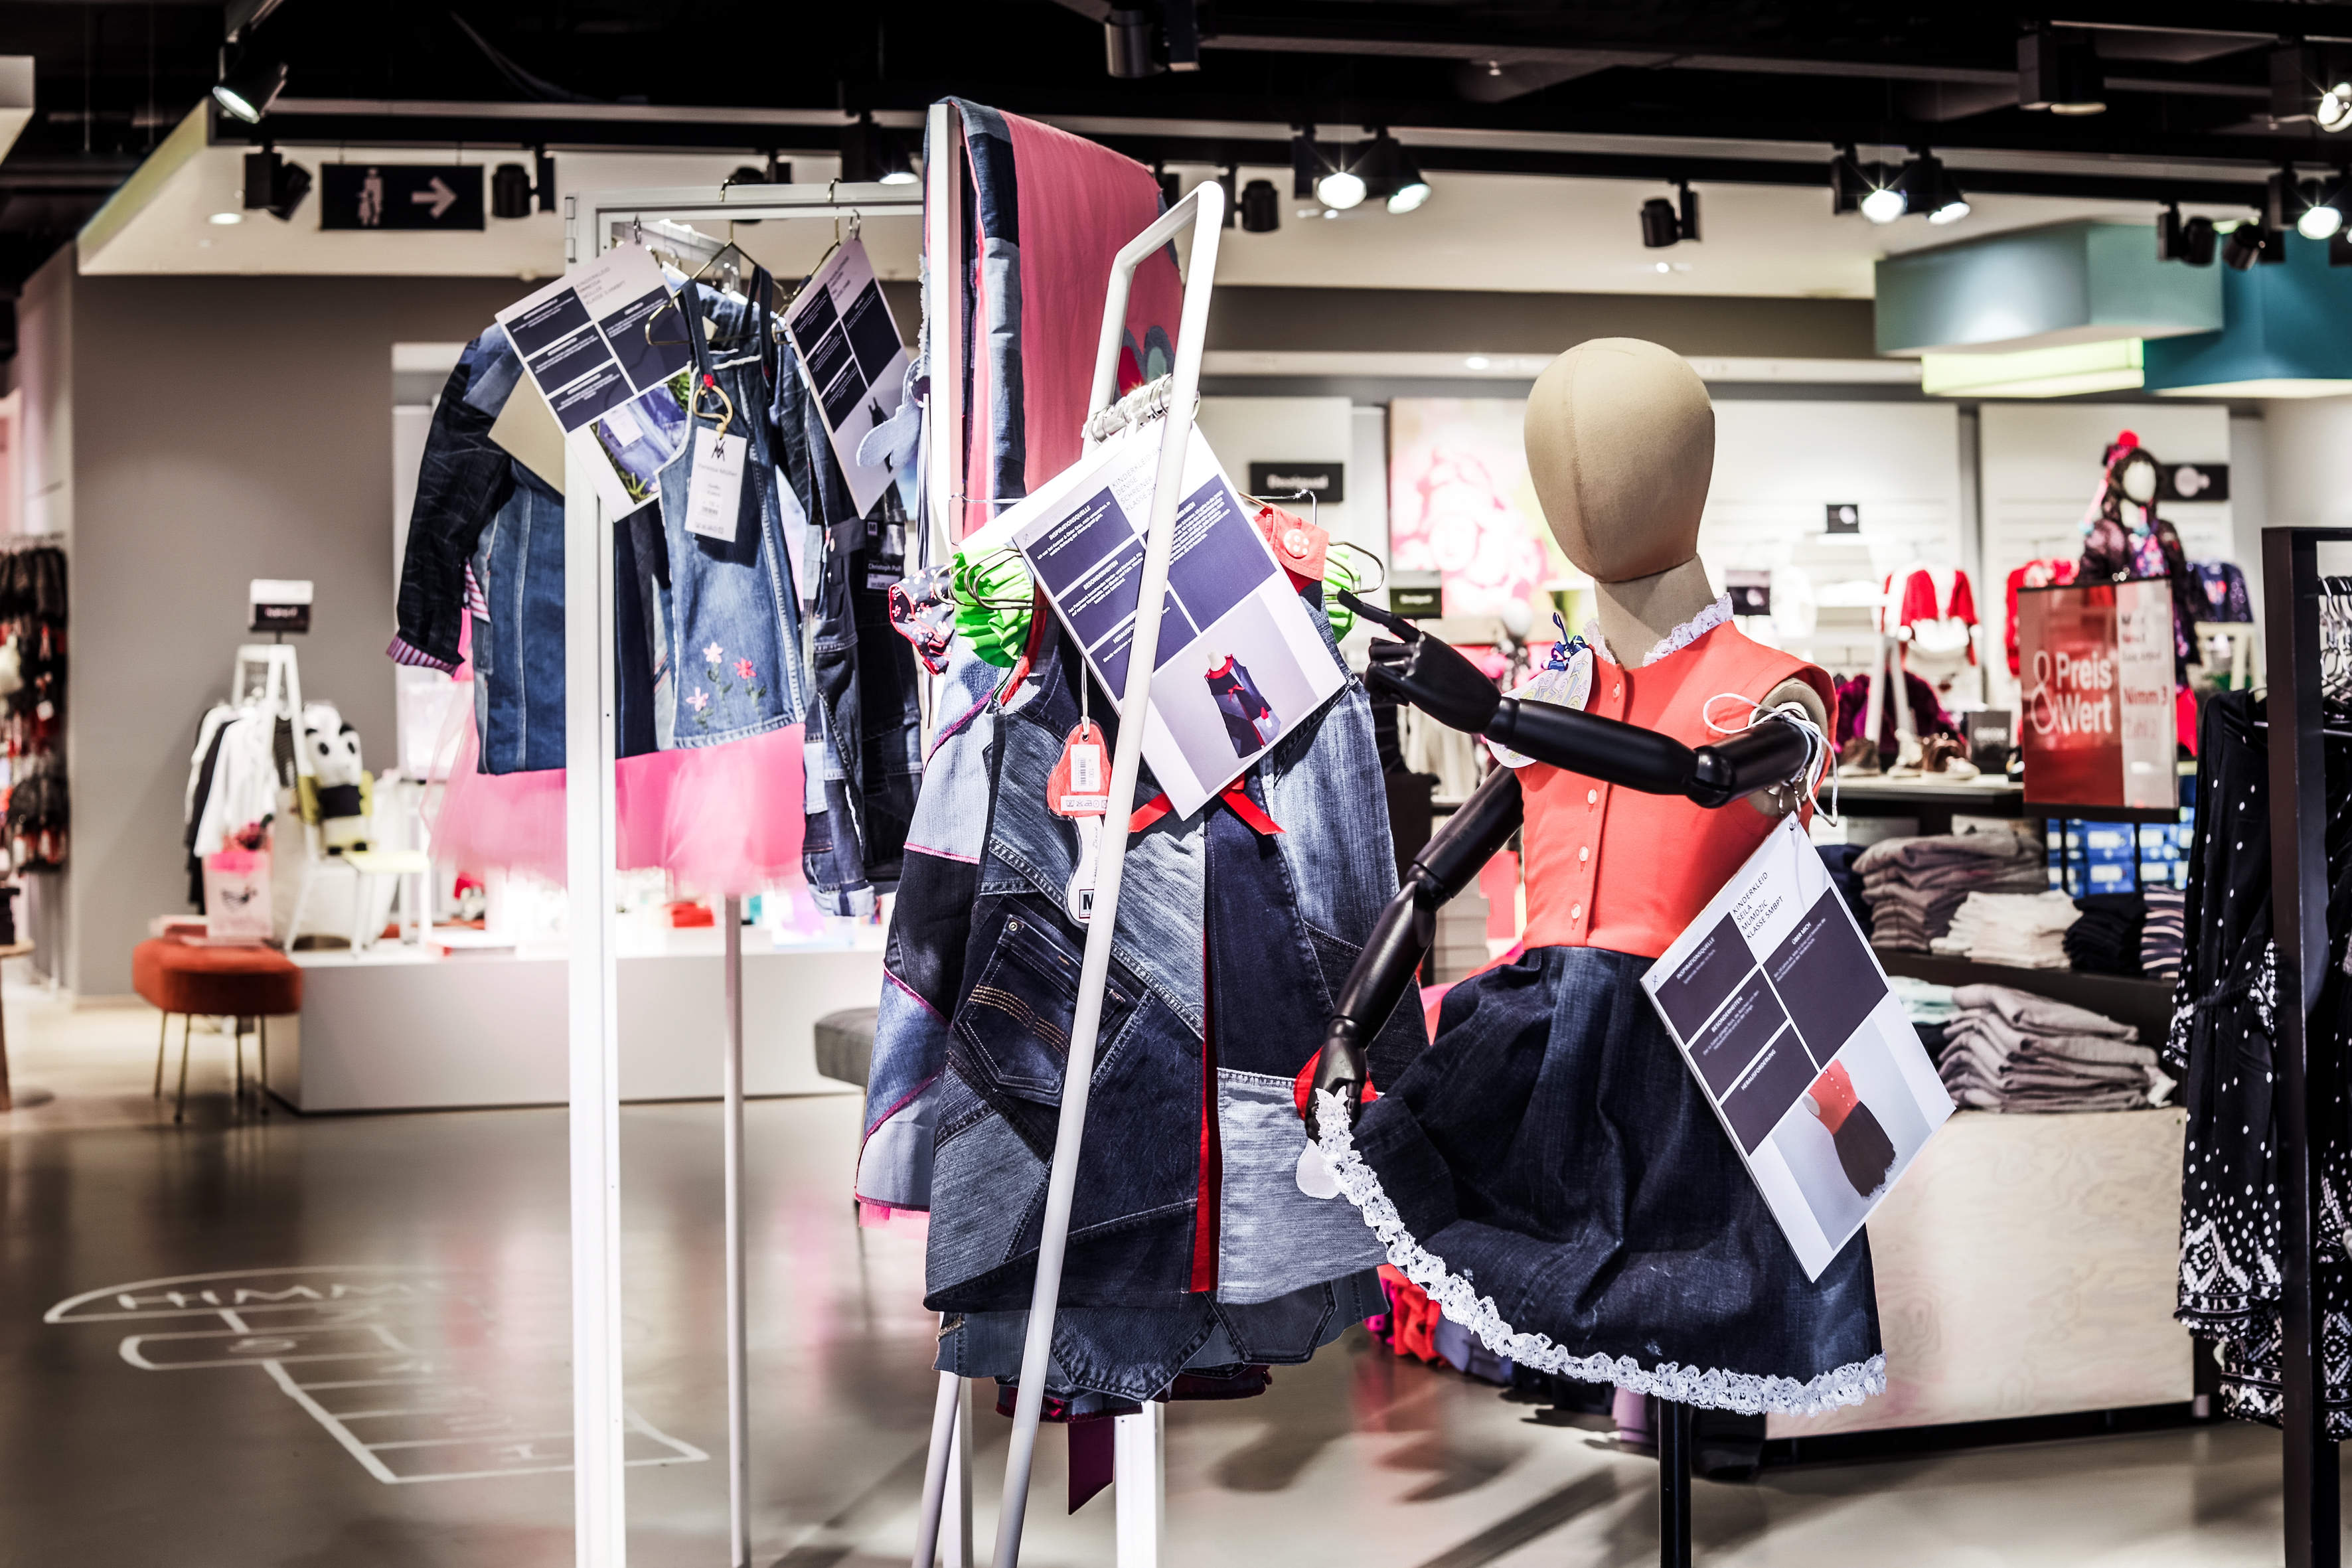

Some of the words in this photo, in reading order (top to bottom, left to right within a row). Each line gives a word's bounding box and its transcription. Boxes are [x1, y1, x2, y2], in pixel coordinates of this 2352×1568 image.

[1048, 504, 1091, 540] INSPIRATIONSQUELLE
[1082, 559, 1119, 590] BESONDERHEITEN
[2055, 651, 2112, 691] Preis
[2057, 694, 2113, 734] Wert
[1732, 870, 1768, 915] KINDERKLEID
[1736, 902, 1753, 923] SEILA
[1741, 898, 1768, 931] MUMDZIC
[1745, 915, 1766, 940] KLASSE
[1790, 930, 1803, 946] ÜBER
[1800, 919, 1812, 935] MICH
[1675, 935, 1715, 980] INSPIRATIONSQUELLE
[1711, 994, 1743, 1033] BESONDERHEITEN
[1740, 1048, 1776, 1091] HERAUSFORDERUNG
